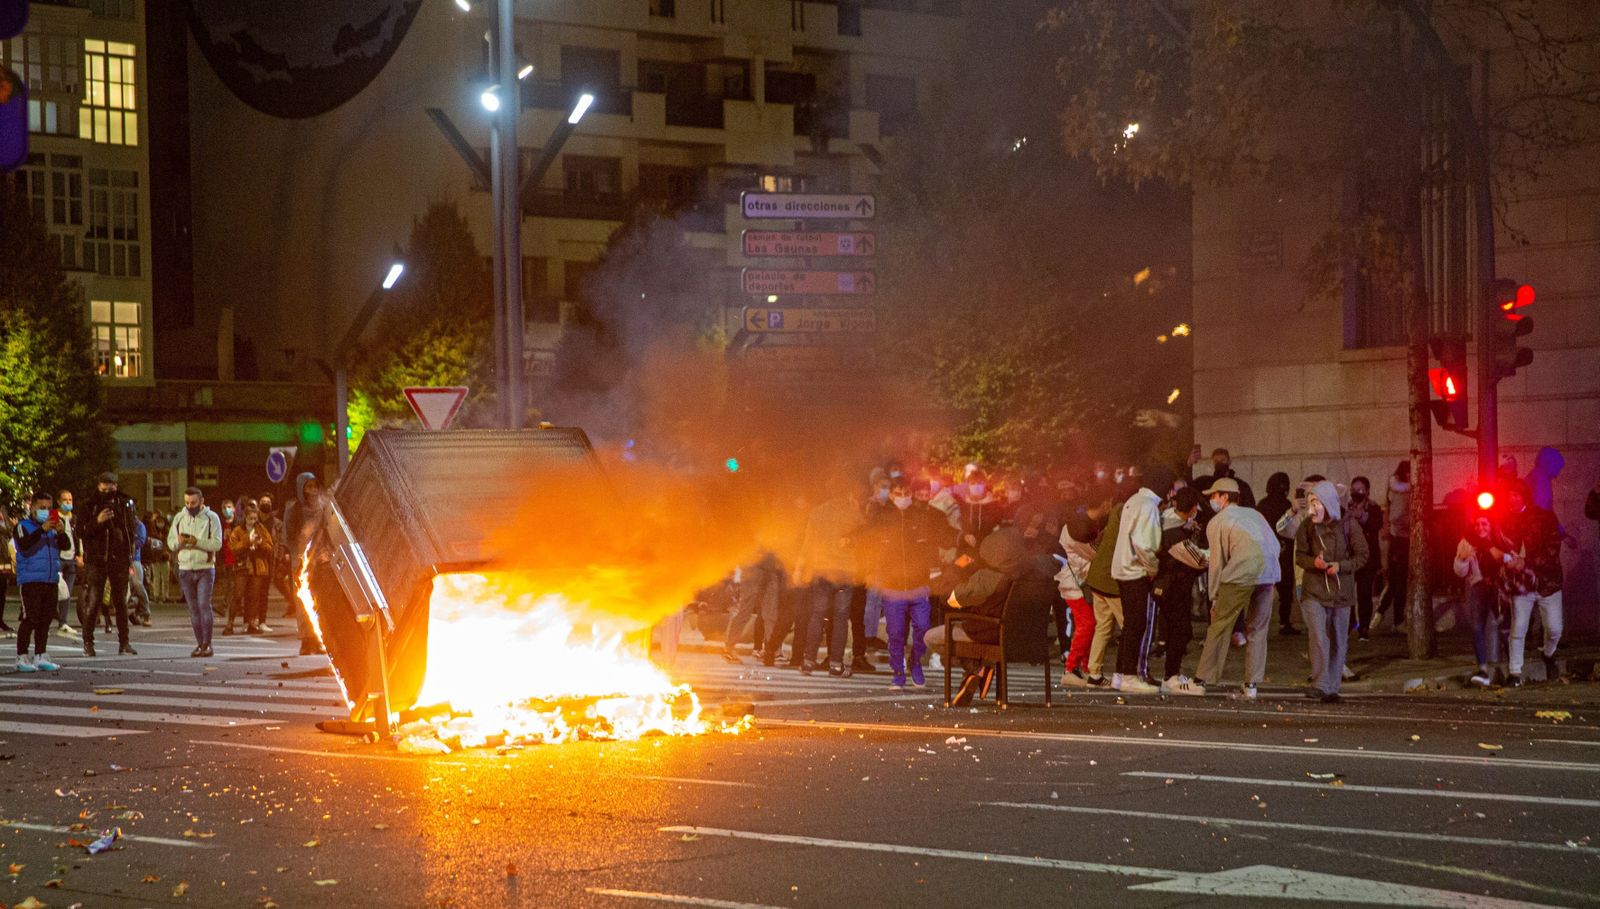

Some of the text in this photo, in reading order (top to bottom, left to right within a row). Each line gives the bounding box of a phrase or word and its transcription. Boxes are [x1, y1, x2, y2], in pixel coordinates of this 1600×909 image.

[747, 200, 850, 212] otras direcciones
[781, 233, 792, 242] de
[747, 243, 820, 254] Las Gaunas
[747, 272, 807, 283] palacio de
